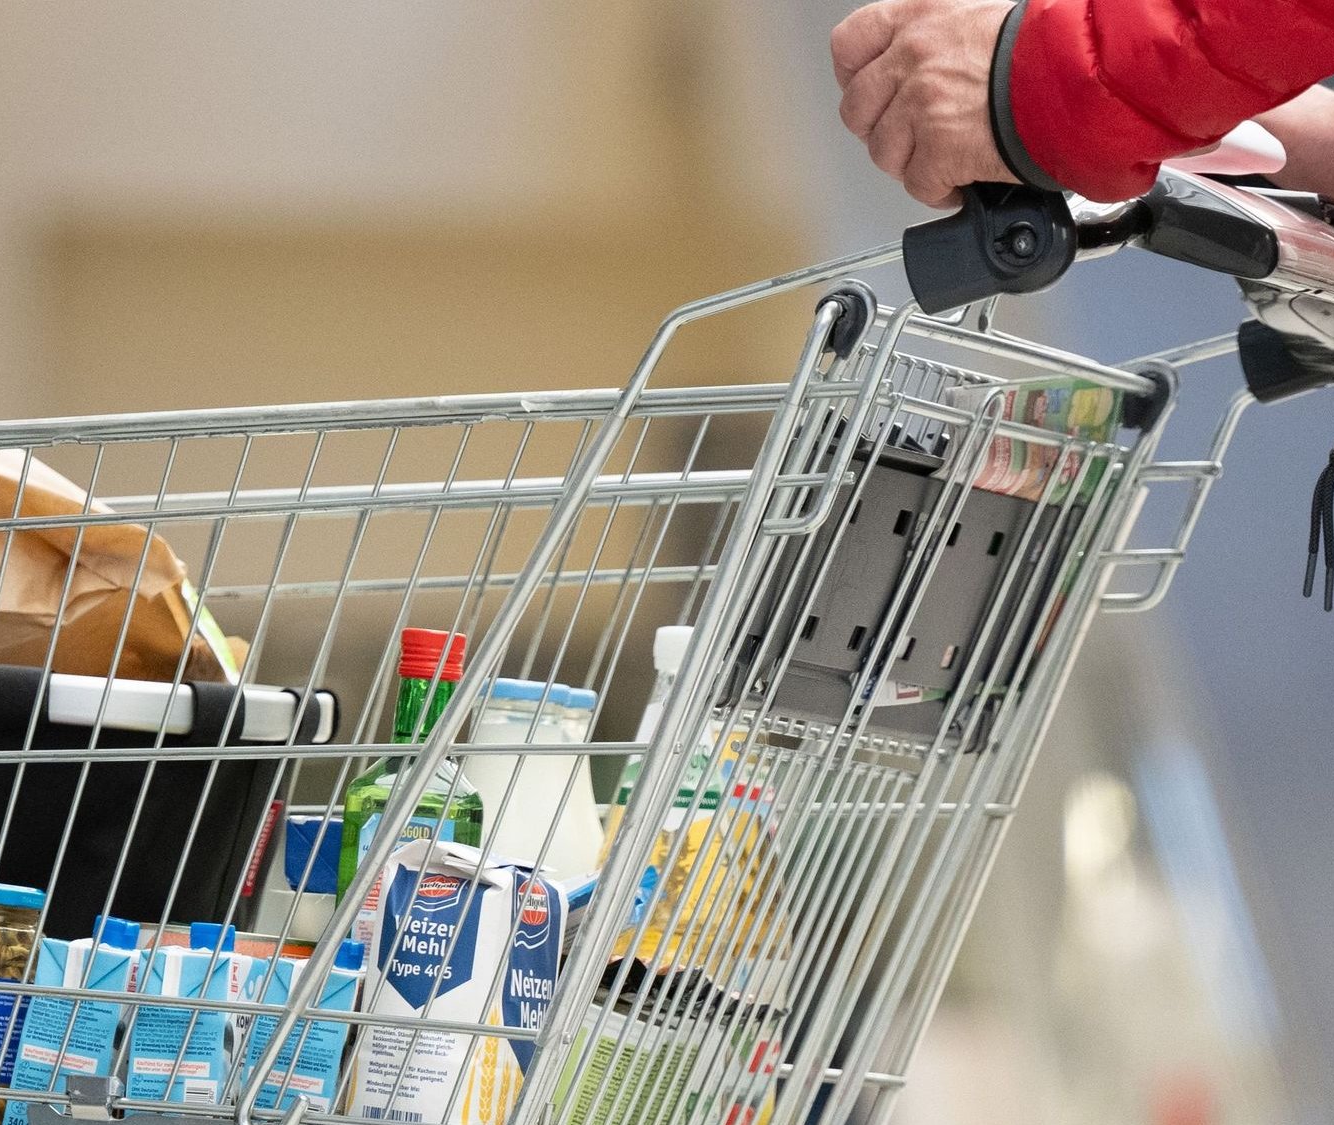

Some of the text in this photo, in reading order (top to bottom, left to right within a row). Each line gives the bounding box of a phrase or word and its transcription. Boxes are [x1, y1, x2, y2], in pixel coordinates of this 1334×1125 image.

[402, 825, 429, 839] SGOLD
[402, 935, 447, 957] Mehl
[392, 959, 421, 978] Type
